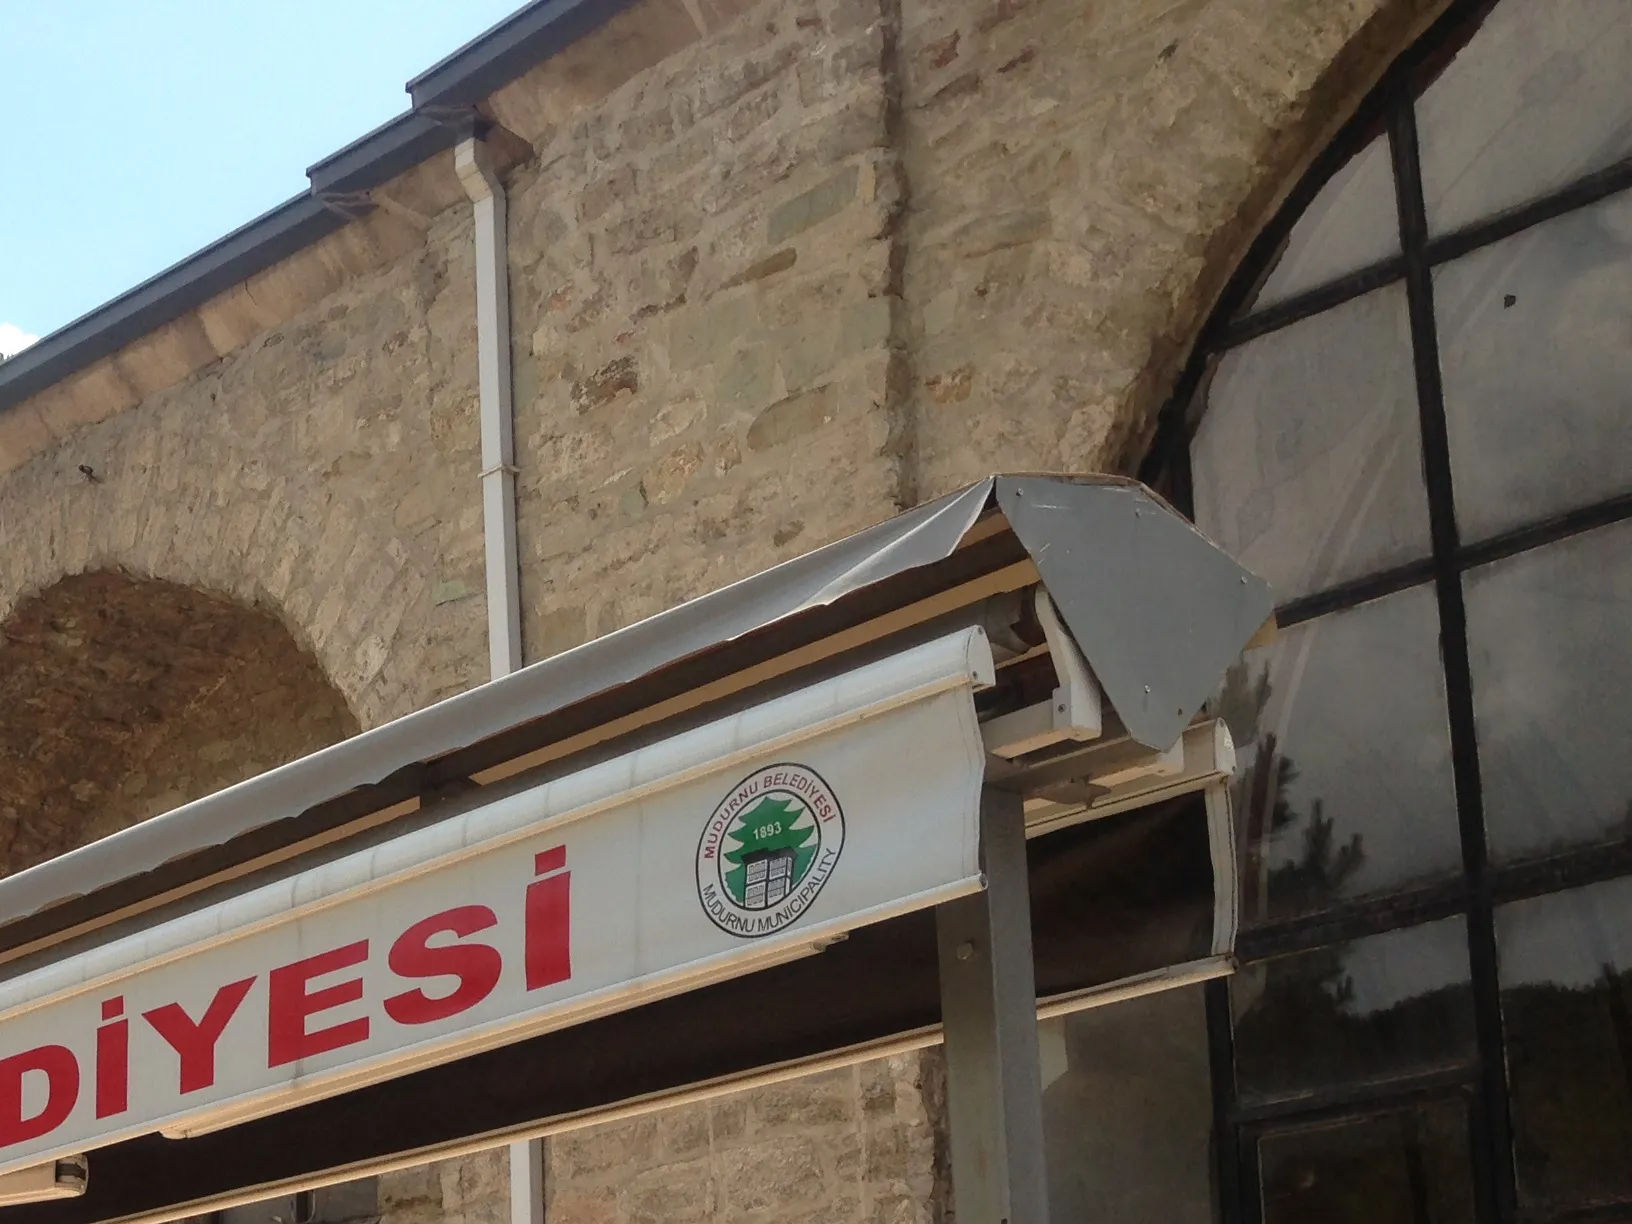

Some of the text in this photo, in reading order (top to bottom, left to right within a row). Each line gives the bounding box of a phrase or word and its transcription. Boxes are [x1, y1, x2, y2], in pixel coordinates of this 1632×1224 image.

[703, 772, 837, 859] MUDURNU BELEDİYESİ
[753, 821, 782, 840] 1893
[703, 883, 756, 933] MUDURNU
